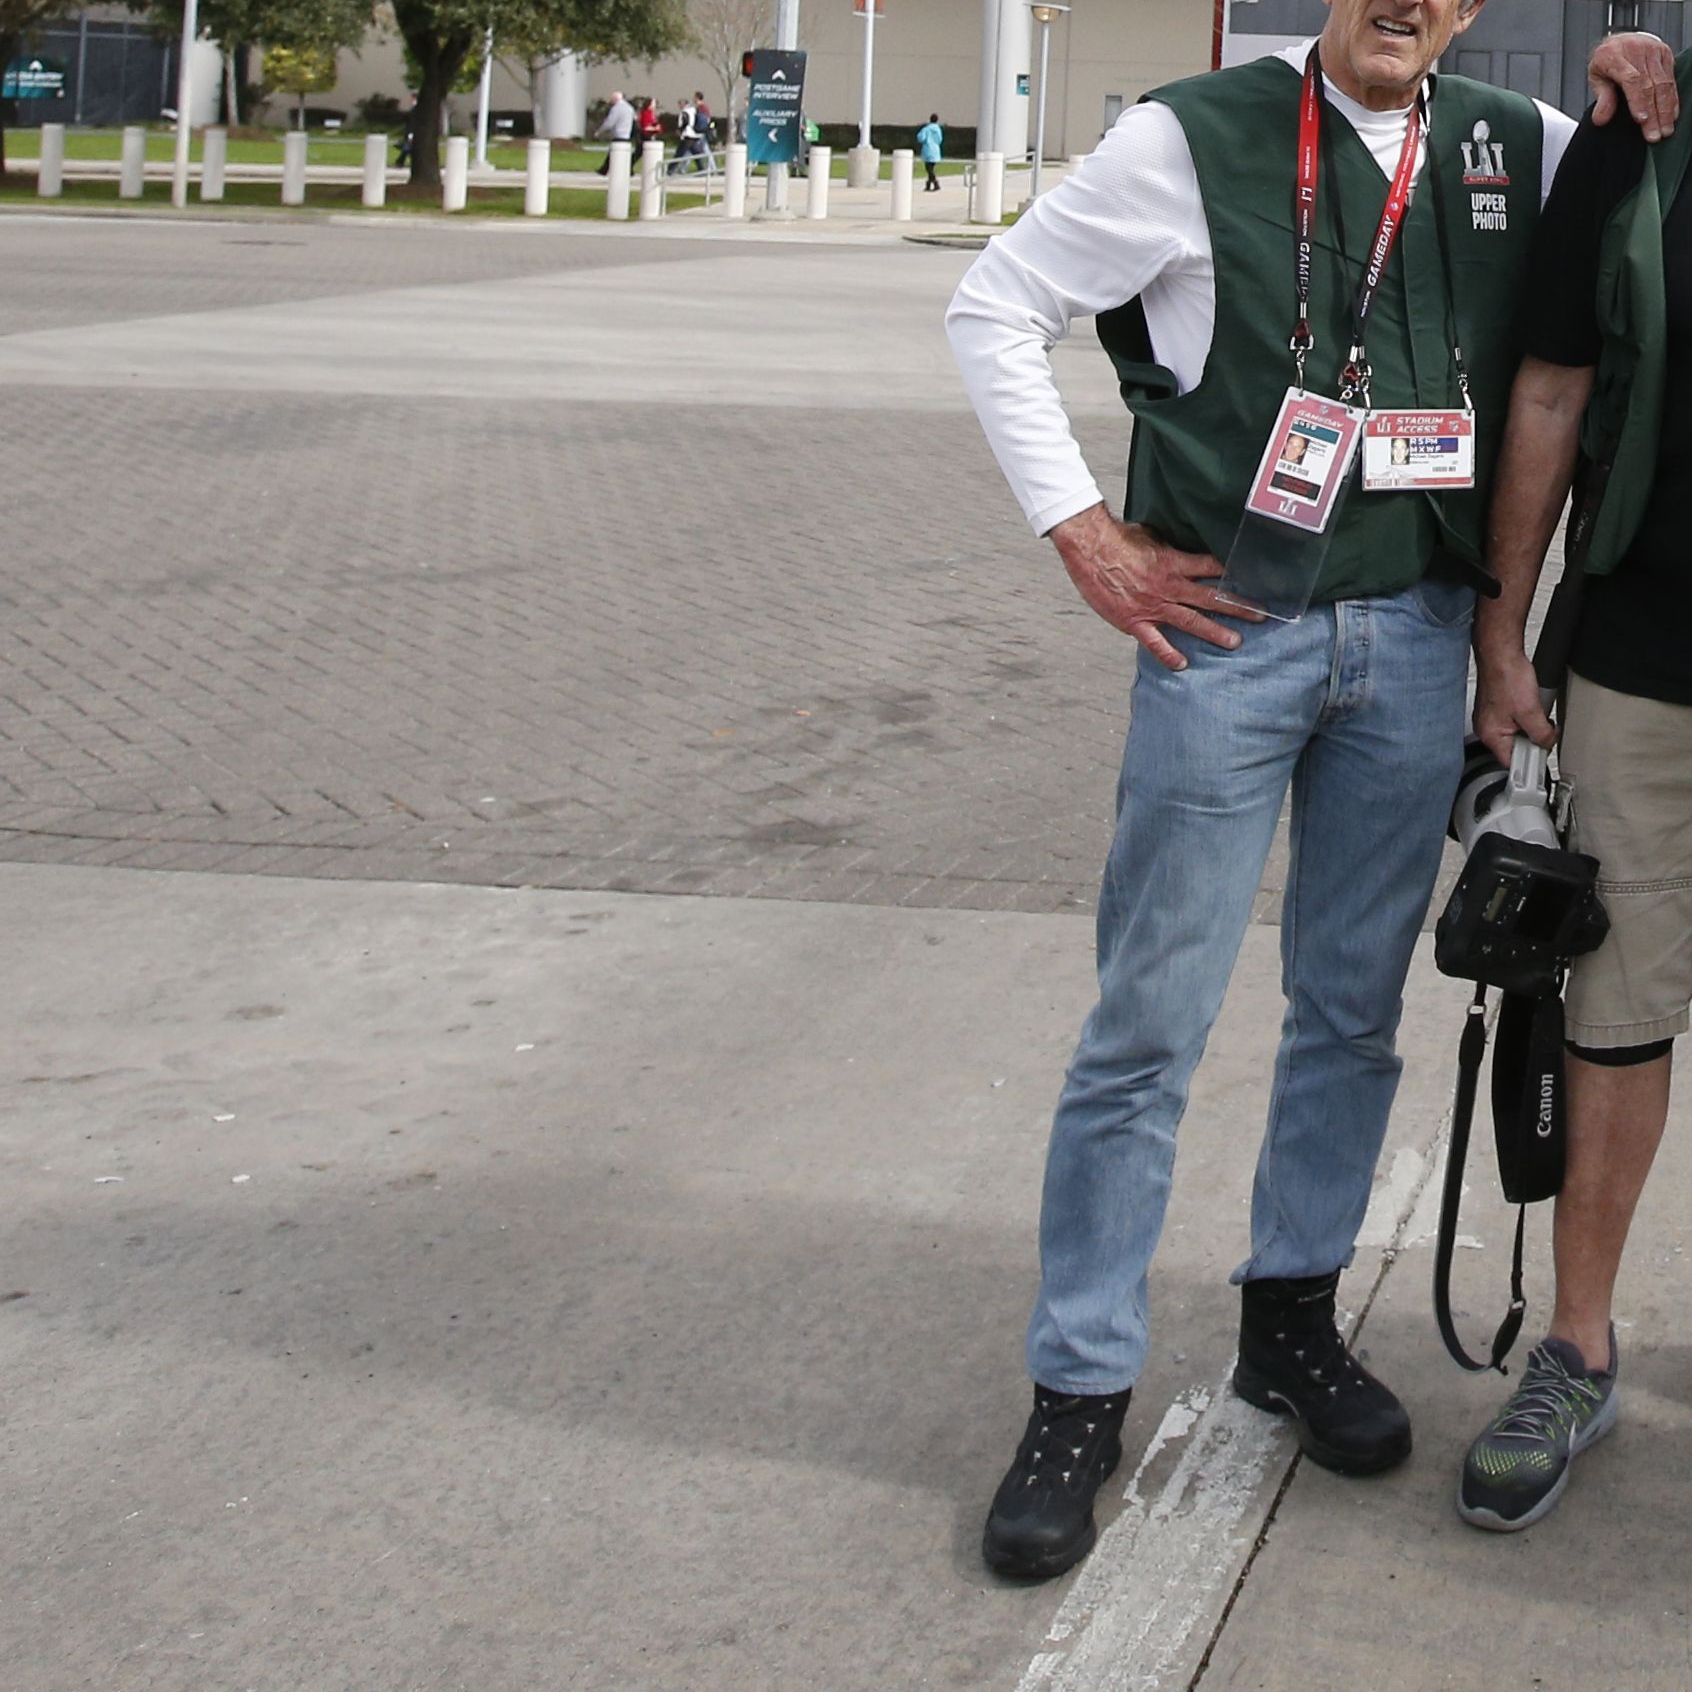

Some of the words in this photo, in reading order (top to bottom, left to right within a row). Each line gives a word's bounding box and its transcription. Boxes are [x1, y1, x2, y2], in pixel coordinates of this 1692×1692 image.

[1471, 193, 1507, 212] UPPER
[1472, 211, 1507, 230] PHOTO
[1367, 215, 1396, 288] GAMEDAY
[1296, 409, 1345, 429] GAMEDAY
[1396, 416, 1444, 426] STADIUM
[1396, 425, 1438, 434] ACCESS
[1537, 1073, 1554, 1138] Canon
